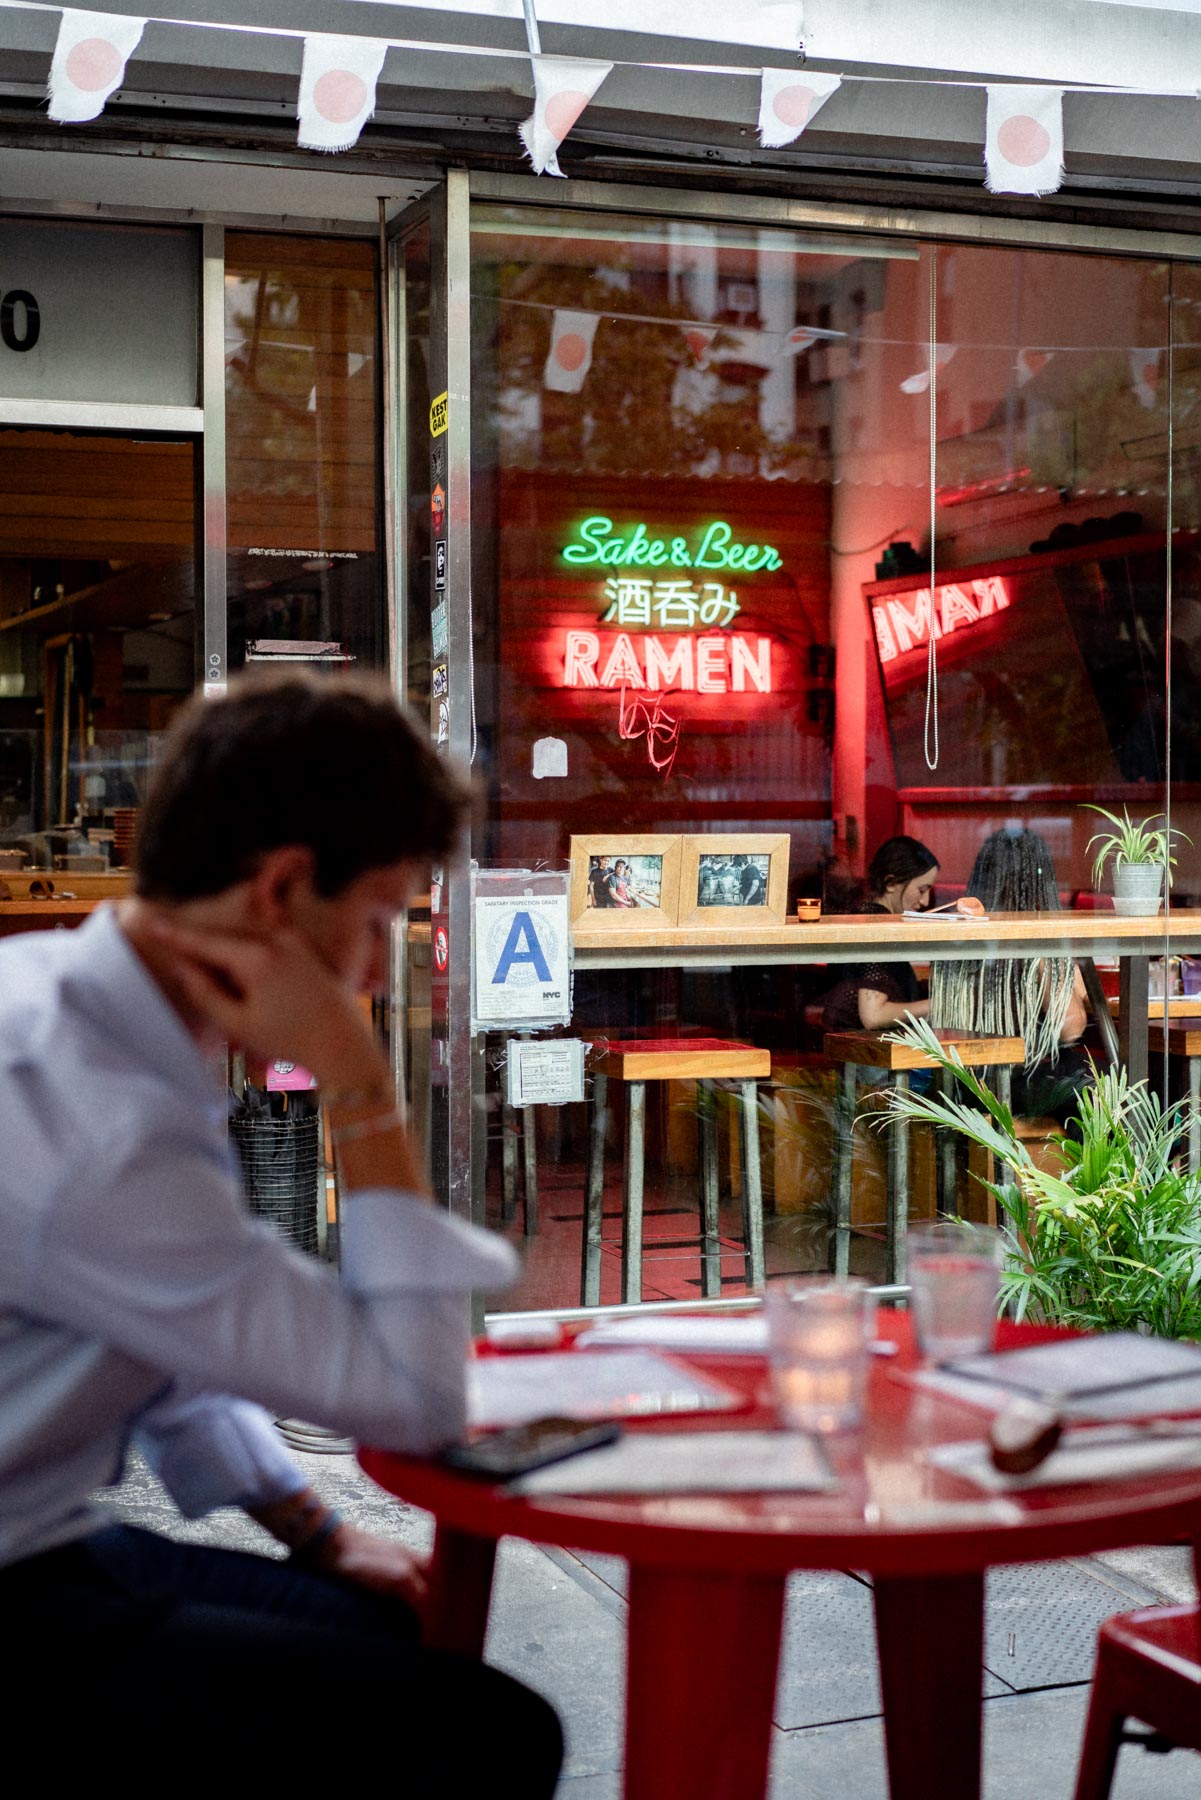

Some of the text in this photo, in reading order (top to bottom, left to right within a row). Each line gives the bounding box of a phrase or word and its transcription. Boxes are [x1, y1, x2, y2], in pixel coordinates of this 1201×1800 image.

[562, 516, 784, 572] Sake & Beer
[604, 577, 742, 627] 酒呑み
[563, 631, 772, 694] RAMEN
[491, 911, 553, 984] A
[542, 991, 561, 999] NYC
